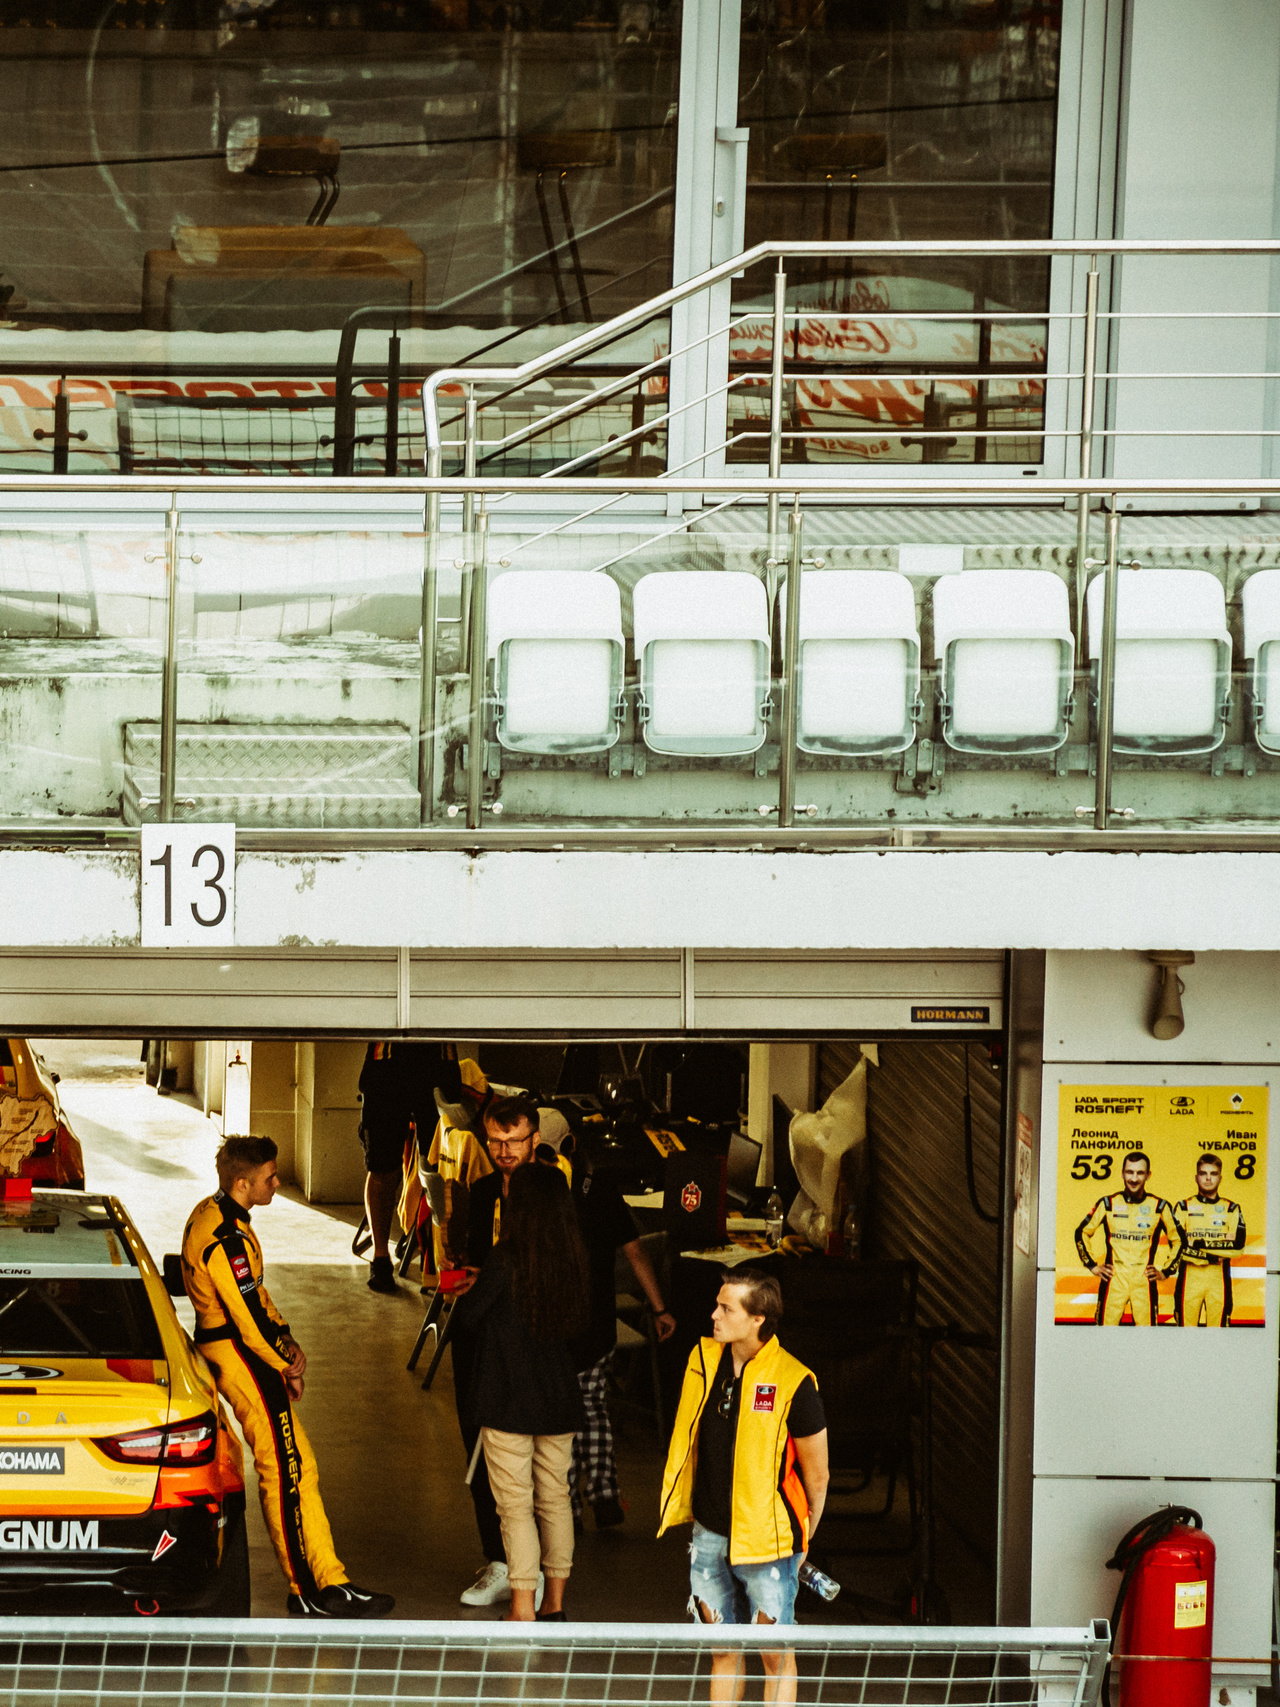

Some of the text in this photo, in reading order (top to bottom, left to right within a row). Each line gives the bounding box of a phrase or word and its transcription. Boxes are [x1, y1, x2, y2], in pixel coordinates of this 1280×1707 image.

[150, 844, 227, 927] 13
[1074, 1105, 1144, 1114] ROSNEFT
[1072, 1128, 1119, 1139] Леонид
[1227, 1129, 1257, 1139] Иван
[1071, 1140, 1144, 1150] ПАНФИЛОВ
[1198, 1141, 1257, 1151] ЧУБАРОВ
[1070, 1154, 1113, 1180] 53
[1234, 1154, 1256, 1180] 8
[1205, 1240, 1234, 1248] VESTA
[1183, 1247, 1207, 1258] ESTA
